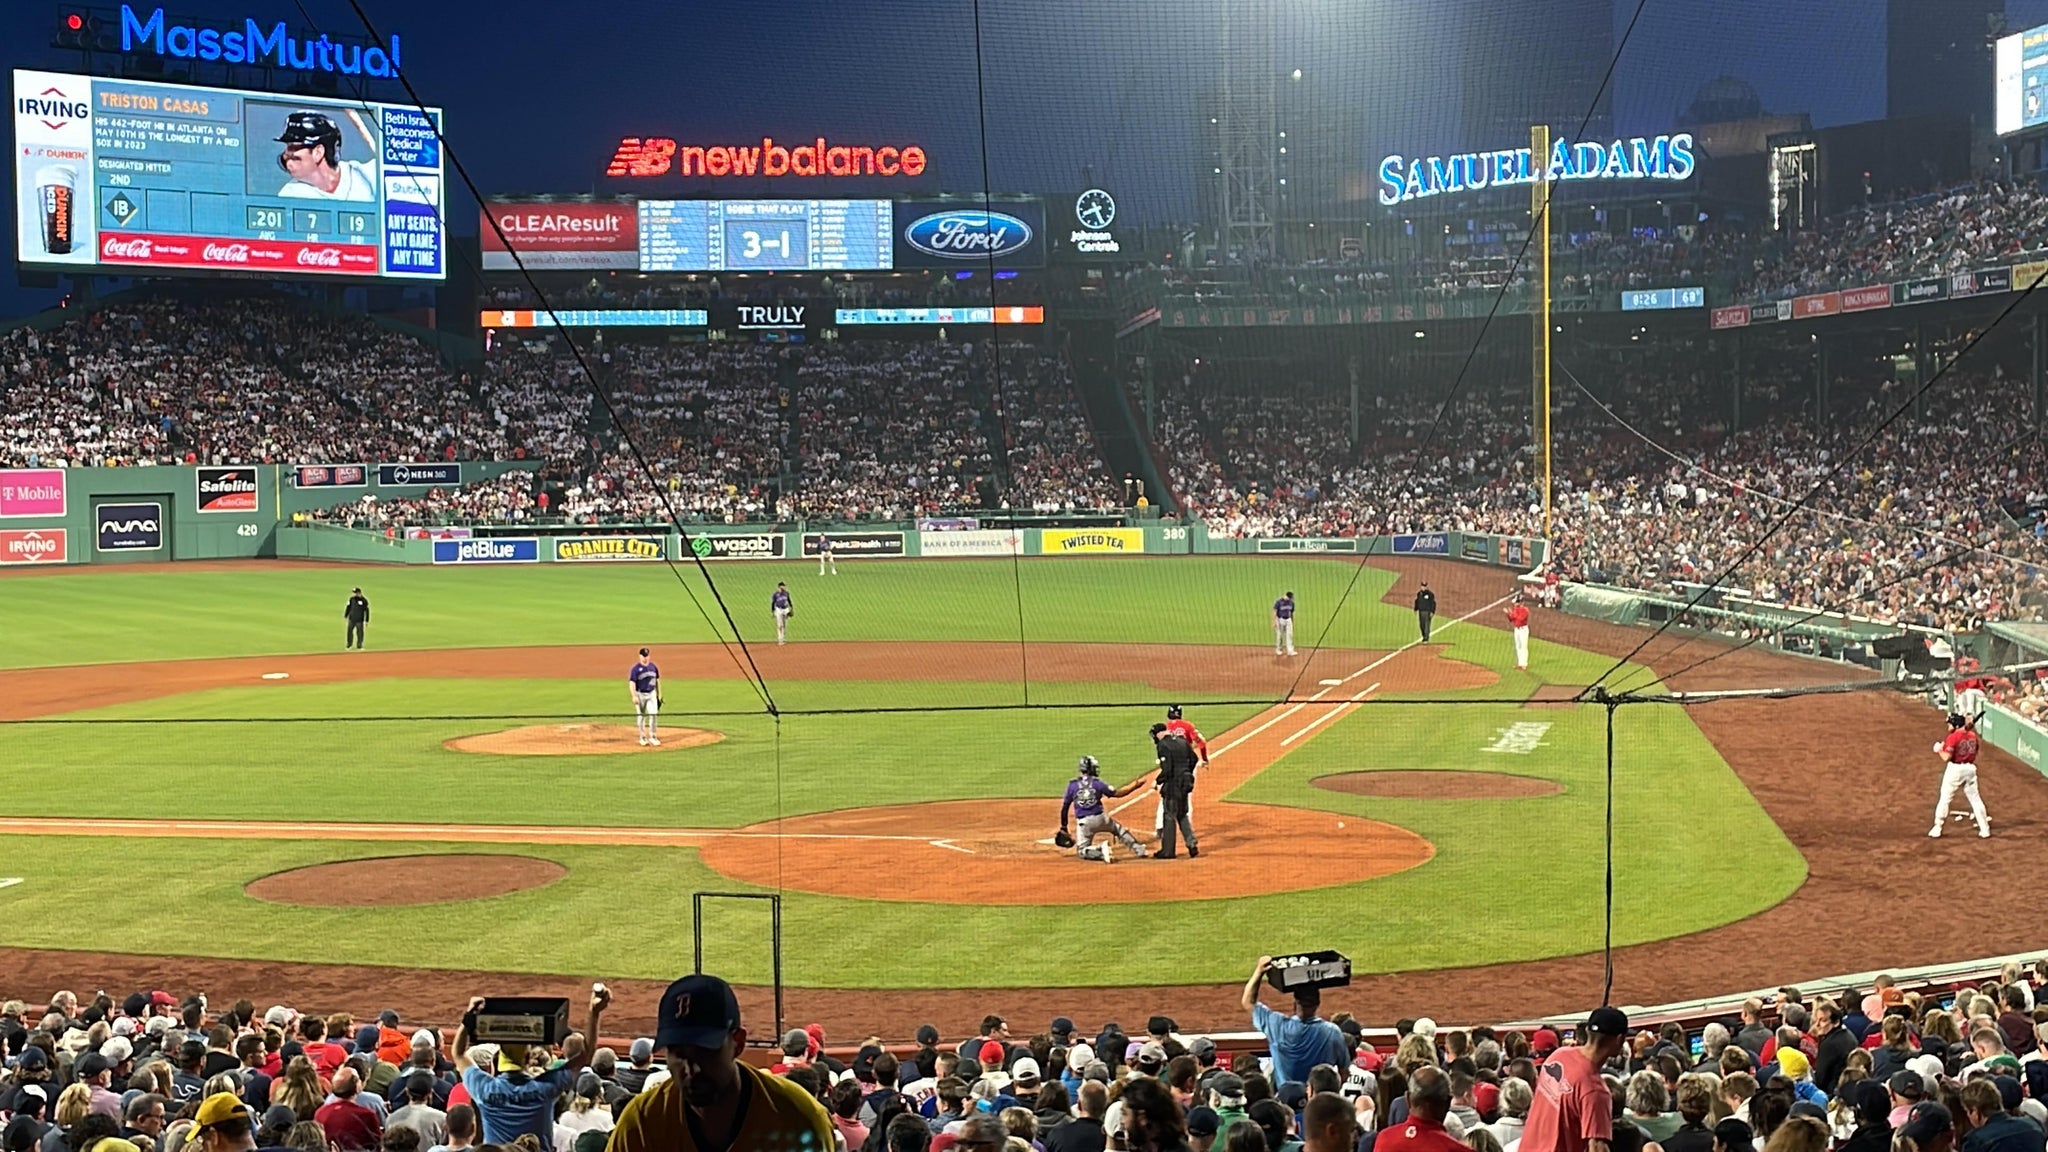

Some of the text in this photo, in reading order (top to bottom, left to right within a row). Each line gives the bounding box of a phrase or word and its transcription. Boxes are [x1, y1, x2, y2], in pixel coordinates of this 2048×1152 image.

[121, 4, 401, 78] MassMutual
[19, 98, 89, 119] IRVING
[100, 93, 209, 115] TRISTON CASAS
[385, 111, 408, 125] Beth
[95, 128, 114, 137] MAY
[149, 132, 163, 142] THE
[166, 133, 200, 145] LONGEST
[177, 124, 213, 135] ATLANTA
[385, 125, 436, 140] Deaconess
[96, 138, 111, 148] SOX
[125, 140, 146, 150] 2023
[99, 160, 171, 173] DESIGNATED HITTER
[1379, 133, 1695, 205] SAMUEL ADAMS
[110, 174, 131, 186] 2ND
[55, 185, 68, 242] DUNKIN'
[252, 211, 282, 228] .201
[308, 213, 317, 229] 7
[350, 216, 365, 232] 19
[388, 214, 439, 234] ANY SEATS,
[500, 213, 620, 233] CLEAResult
[390, 232, 438, 250] ANY GAME,
[931, 217, 1006, 251] Ford
[742, 230, 790, 259] 3-1
[393, 249, 435, 266] ANY TIME
[738, 306, 805, 323] TRULY
[411, 471, 434, 479] NESN
[3, 486, 61, 501] T Mobile
[200, 480, 255, 493] Safelite
[101, 519, 158, 534] nuna
[237, 524, 258, 537] 420
[1163, 527, 1186, 540] 380
[9, 539, 56, 553] IRVING
[559, 537, 660, 558] GRANITE CITY
[713, 536, 773, 552] wasabi
[924, 540, 947, 548] BANK
[1061, 535, 1124, 550] TWISTED TEA
[457, 541, 515, 562] jetBlue
[675, 993, 691, 1019] B
